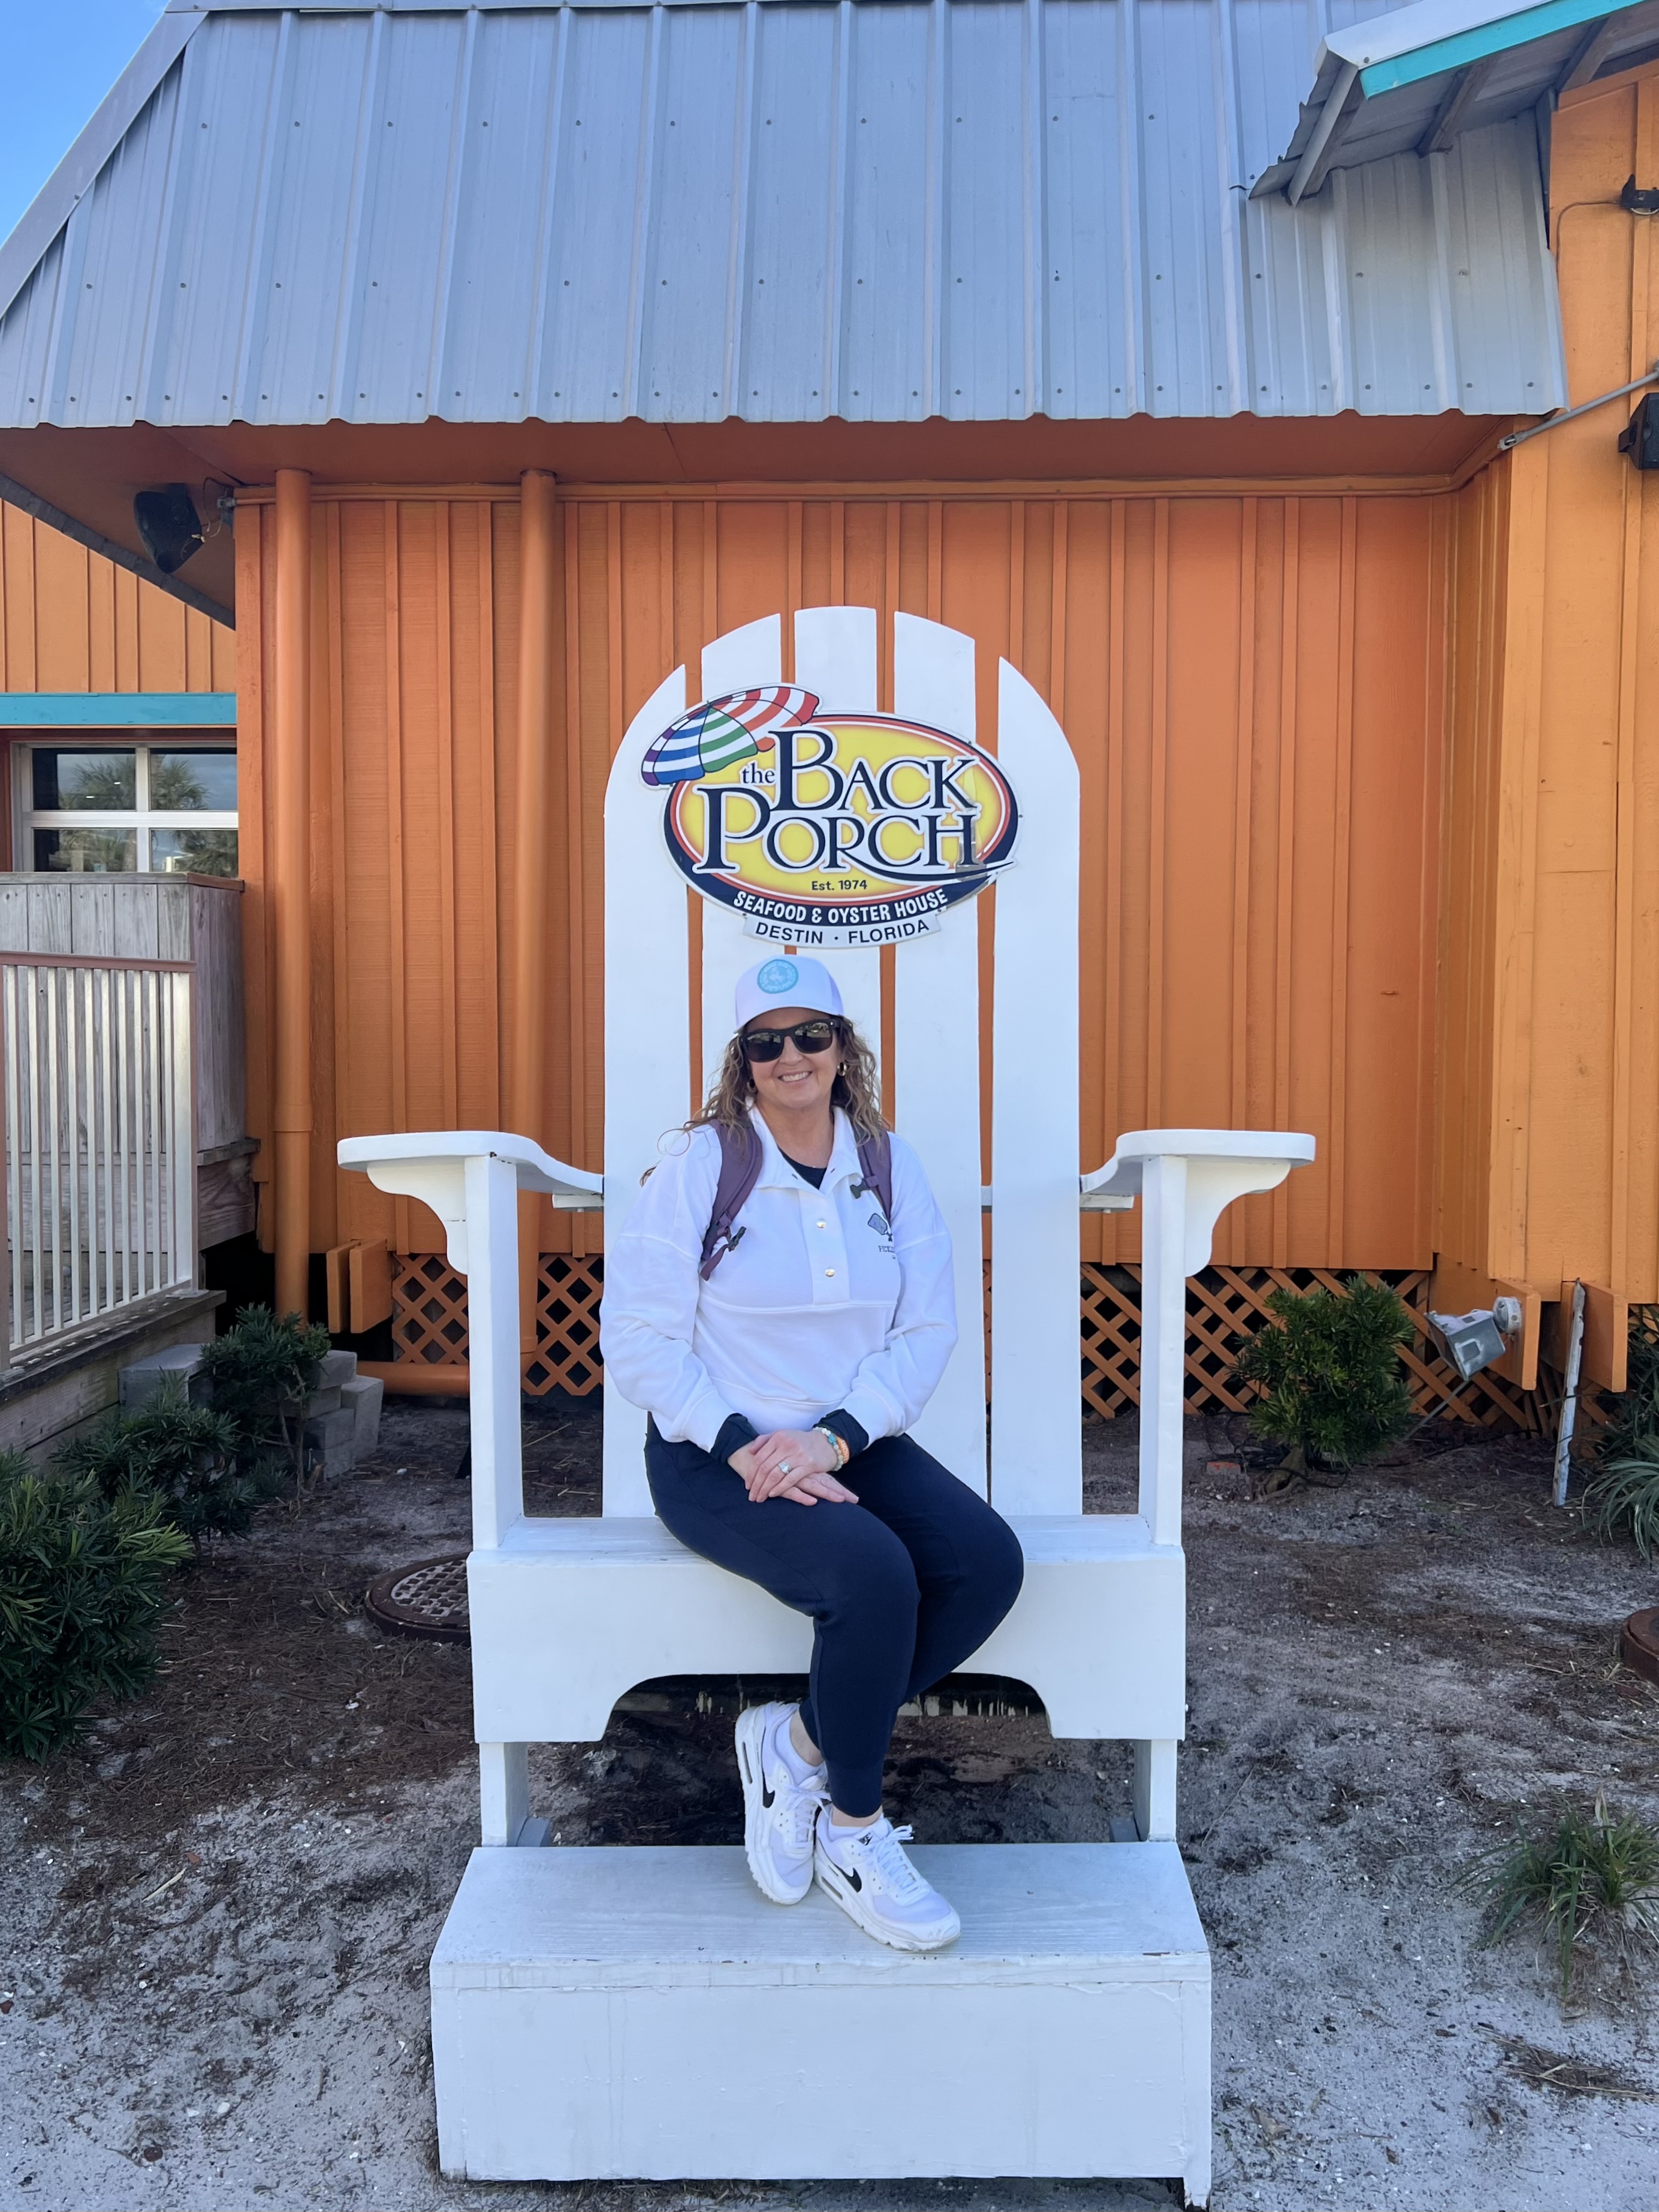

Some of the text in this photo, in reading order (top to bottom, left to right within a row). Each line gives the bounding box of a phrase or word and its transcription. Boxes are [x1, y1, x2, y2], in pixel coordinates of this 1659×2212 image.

[741, 730, 979, 811] the BACK
[696, 787, 1014, 881] PORCH
[812, 880, 867, 891] Est. 1974
[733, 889, 948, 924] SEAFOOD & OYSTER HOUSE
[755, 919, 930, 944] DESTIN FLORIDA
